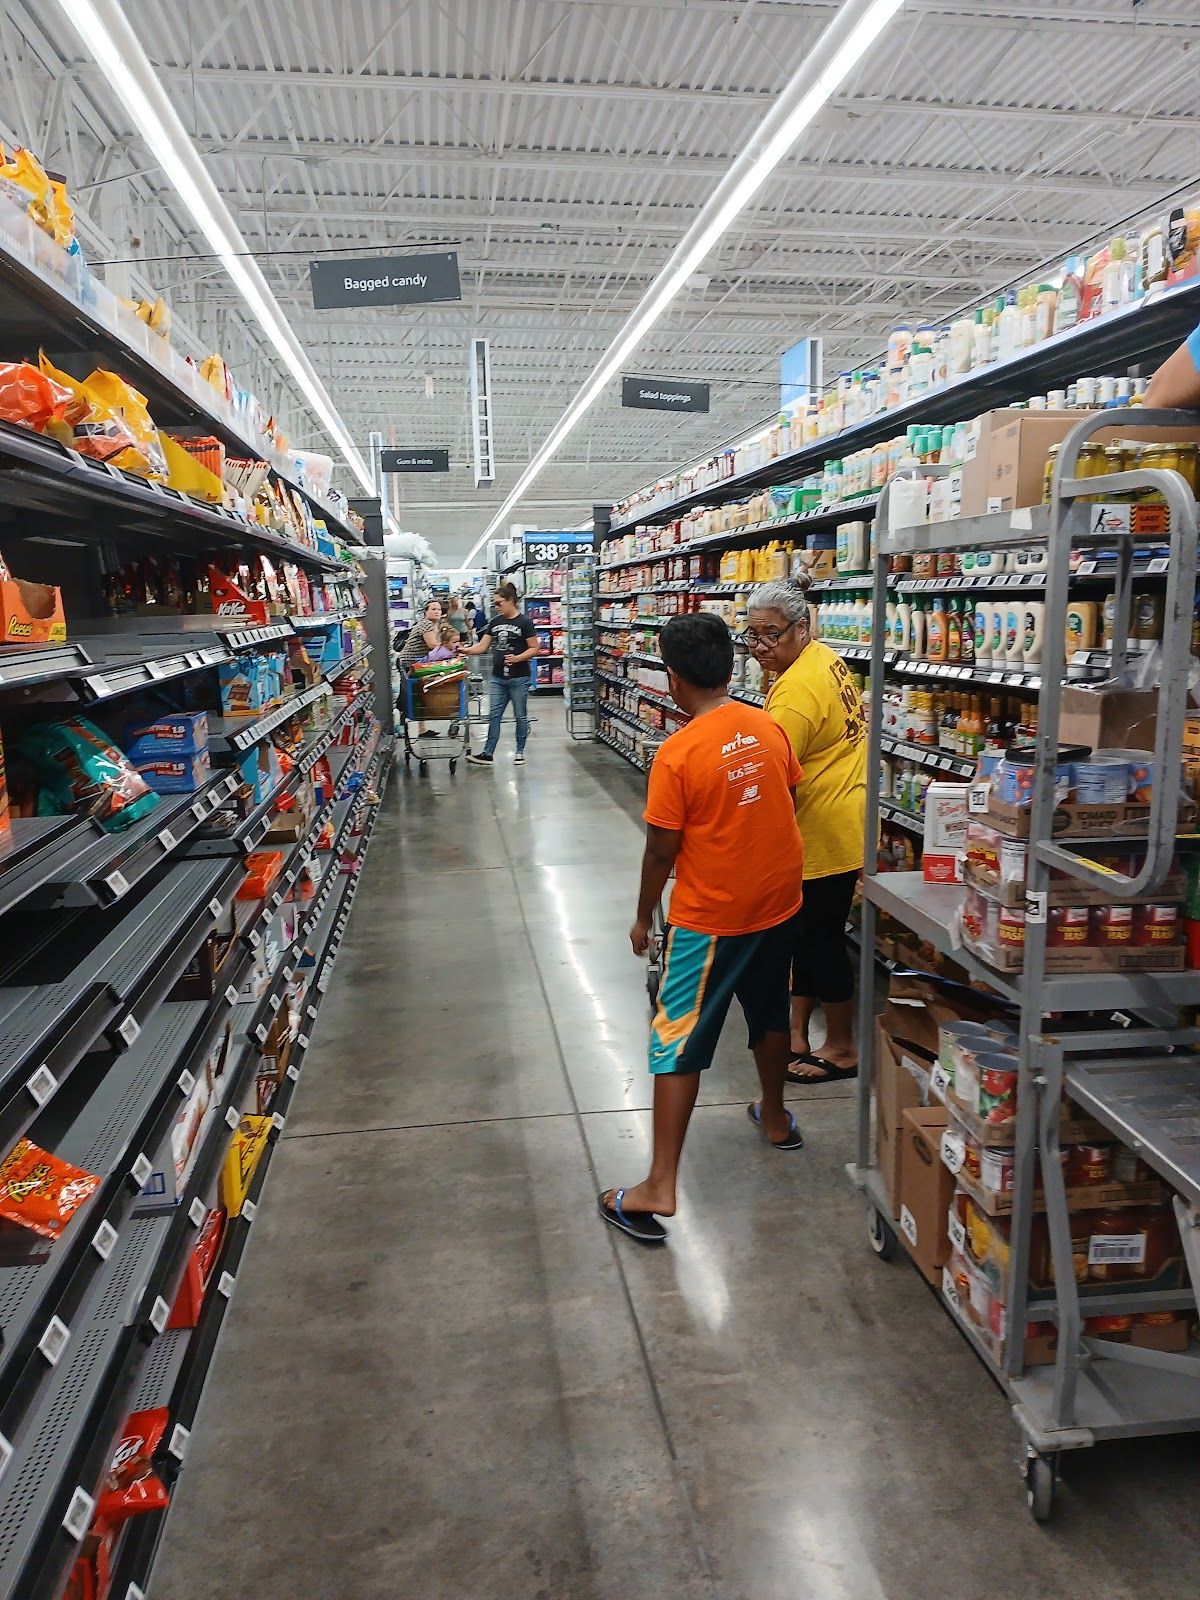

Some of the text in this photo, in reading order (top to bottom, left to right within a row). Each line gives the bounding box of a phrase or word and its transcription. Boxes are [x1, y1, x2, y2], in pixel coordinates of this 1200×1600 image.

[344, 273, 427, 291] Bagged candy
[639, 389, 692, 404] Salad toppings
